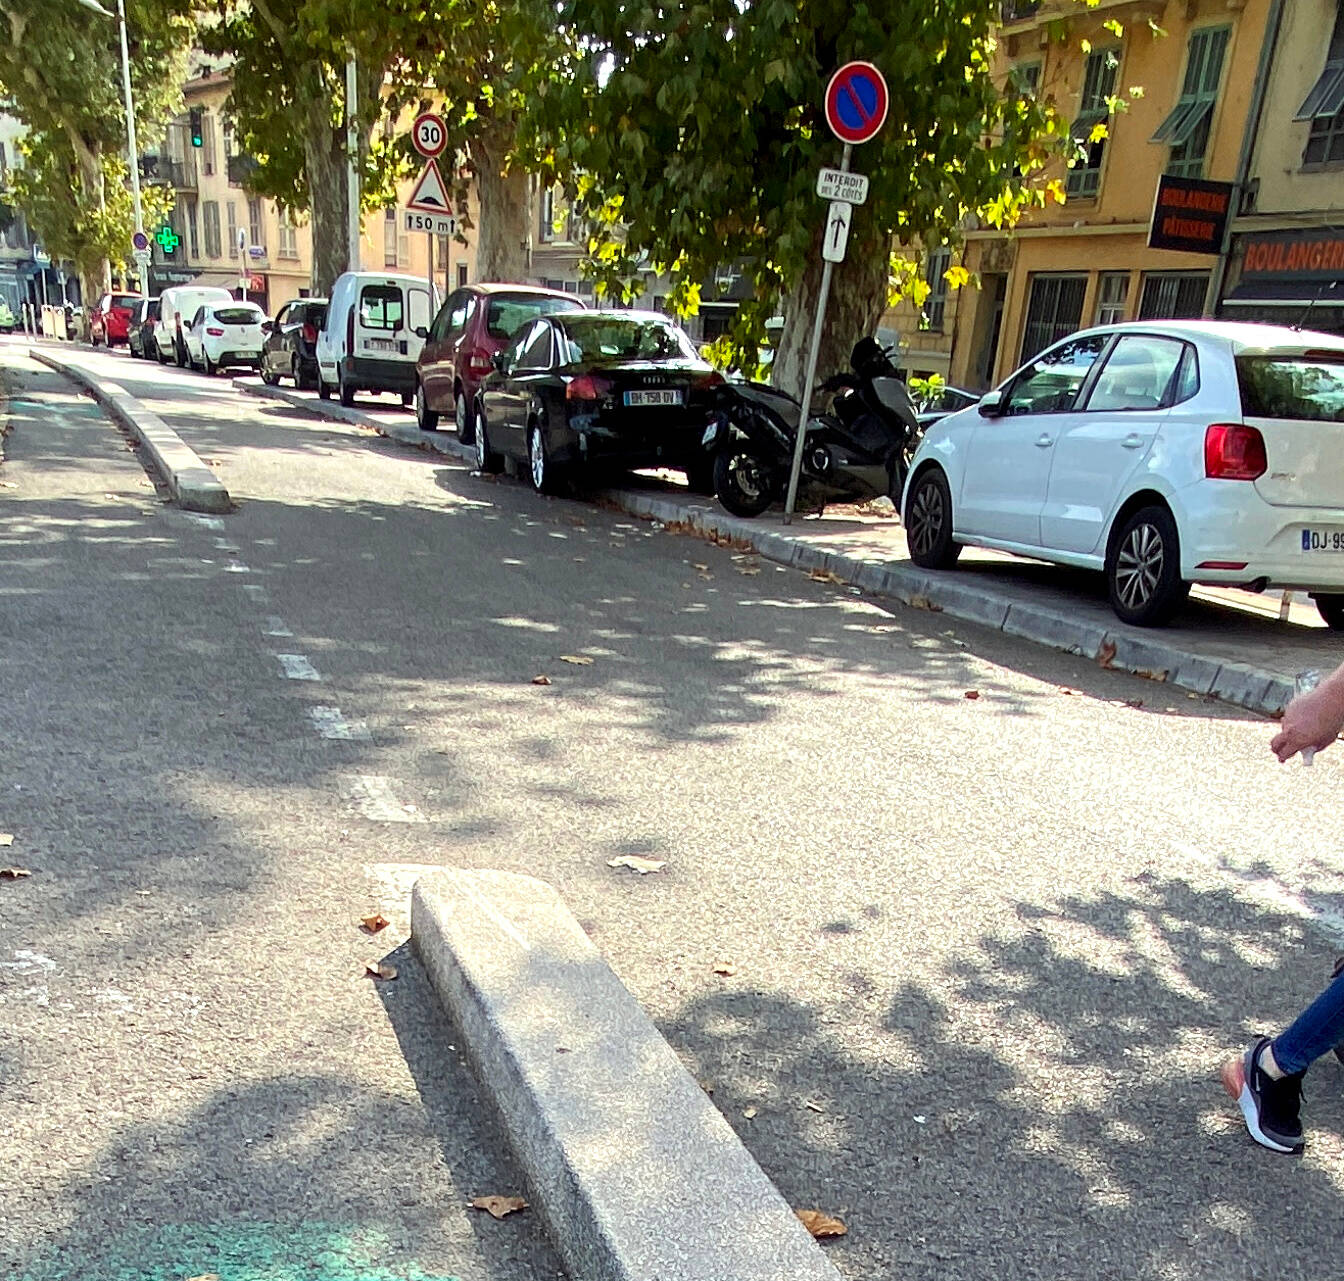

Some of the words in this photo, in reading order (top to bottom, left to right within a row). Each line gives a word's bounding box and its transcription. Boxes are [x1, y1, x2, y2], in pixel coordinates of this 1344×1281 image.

[421, 126, 440, 143] 30
[823, 172, 864, 188] INTERDIT
[834, 184, 841, 197] 2
[416, 215, 432, 230] 50
[437, 221, 448, 232] m
